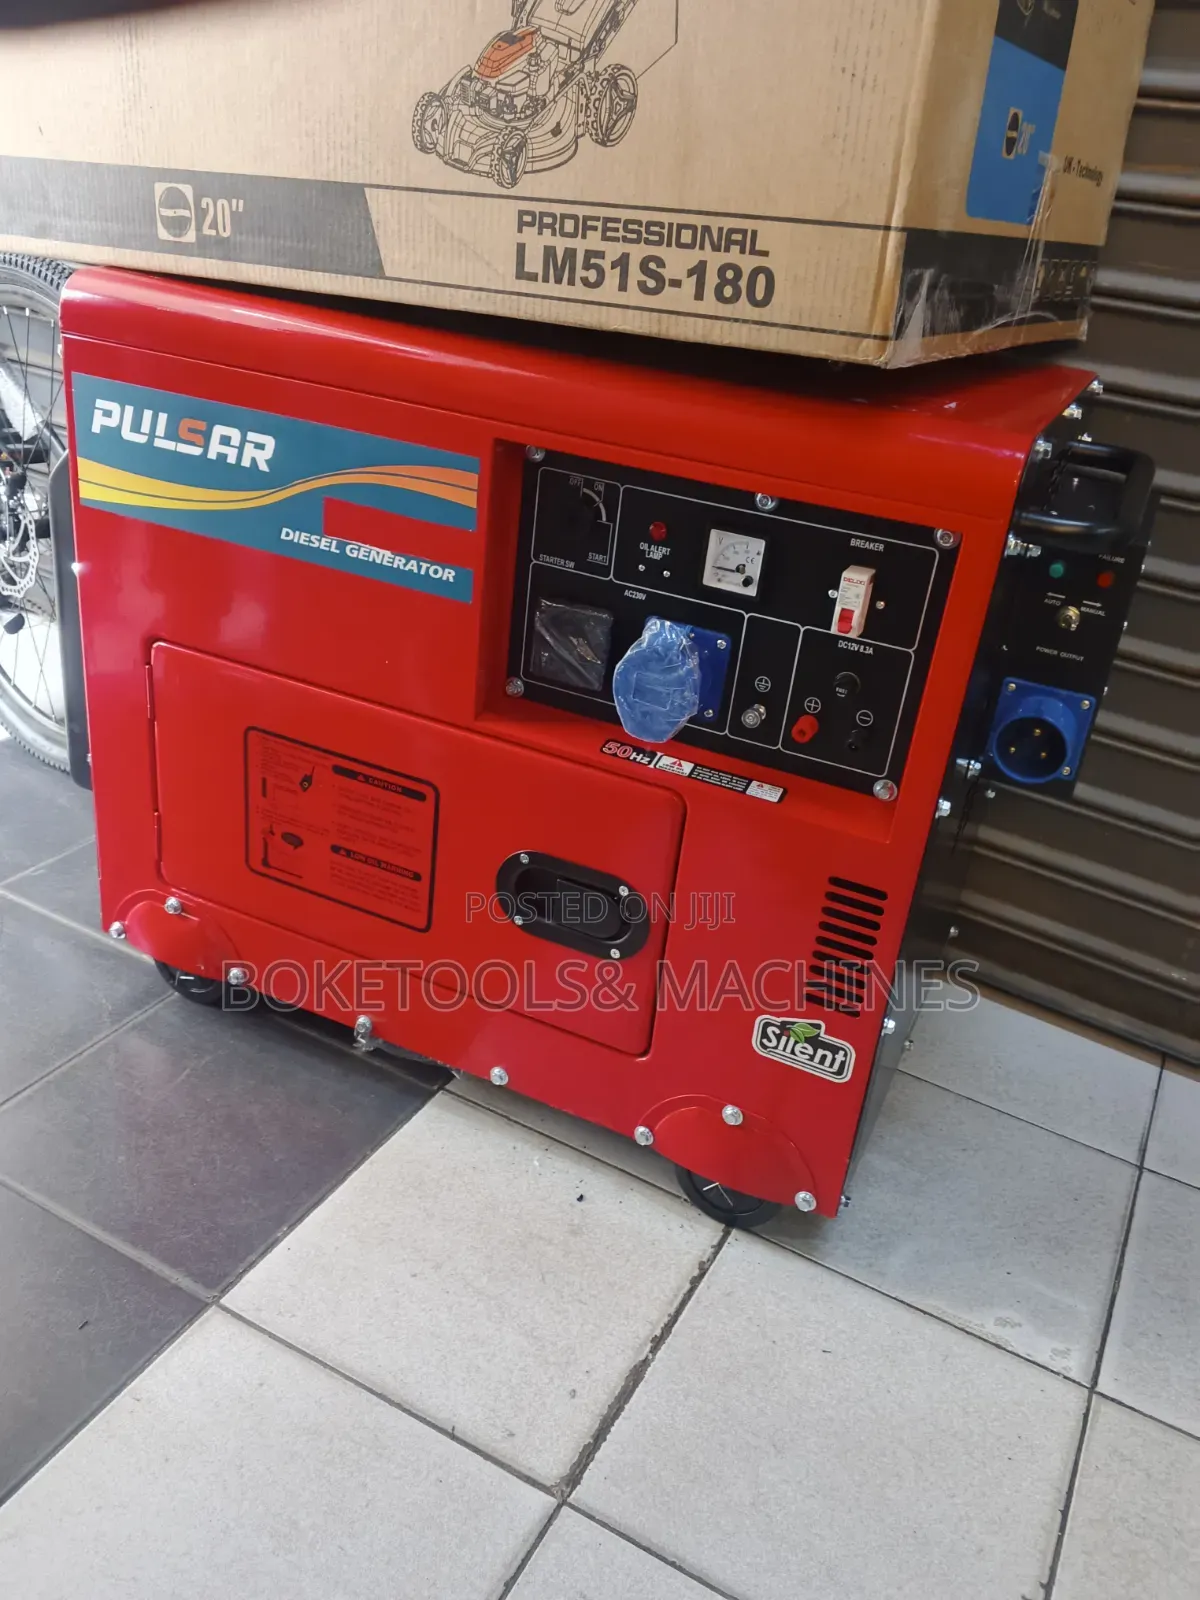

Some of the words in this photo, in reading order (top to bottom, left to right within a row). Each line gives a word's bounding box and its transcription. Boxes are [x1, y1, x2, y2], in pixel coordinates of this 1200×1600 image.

[201, 196, 244, 238] 20"
[517, 209, 770, 258] PROFESSIONAL
[515, 242, 775, 308] LM51S-180
[91, 398, 276, 472] PULSAR
[650, 545, 671, 556] ALERT
[850, 538, 884, 551] BREAKER
[280, 527, 340, 554] DIESEL
[345, 544, 456, 583] GENERATOR
[539, 554, 565, 567] STARTER
[565, 561, 576, 569] SW
[588, 552, 607, 563] START
[645, 550, 663, 560] LAMP
[624, 590, 647, 601] AC230V
[1044, 598, 1062, 607] AUTO
[1081, 606, 1105, 616] MANUAL
[838, 640, 860, 652] DC12V
[859, 645, 874, 655] 8.3A
[1036, 646, 1058, 656] POWER
[1059, 651, 1084, 662] OUTPUT
[602, 741, 651, 765] 50Hz
[368, 777, 403, 793] CAUTION
[761, 1025, 846, 1072] Silent
